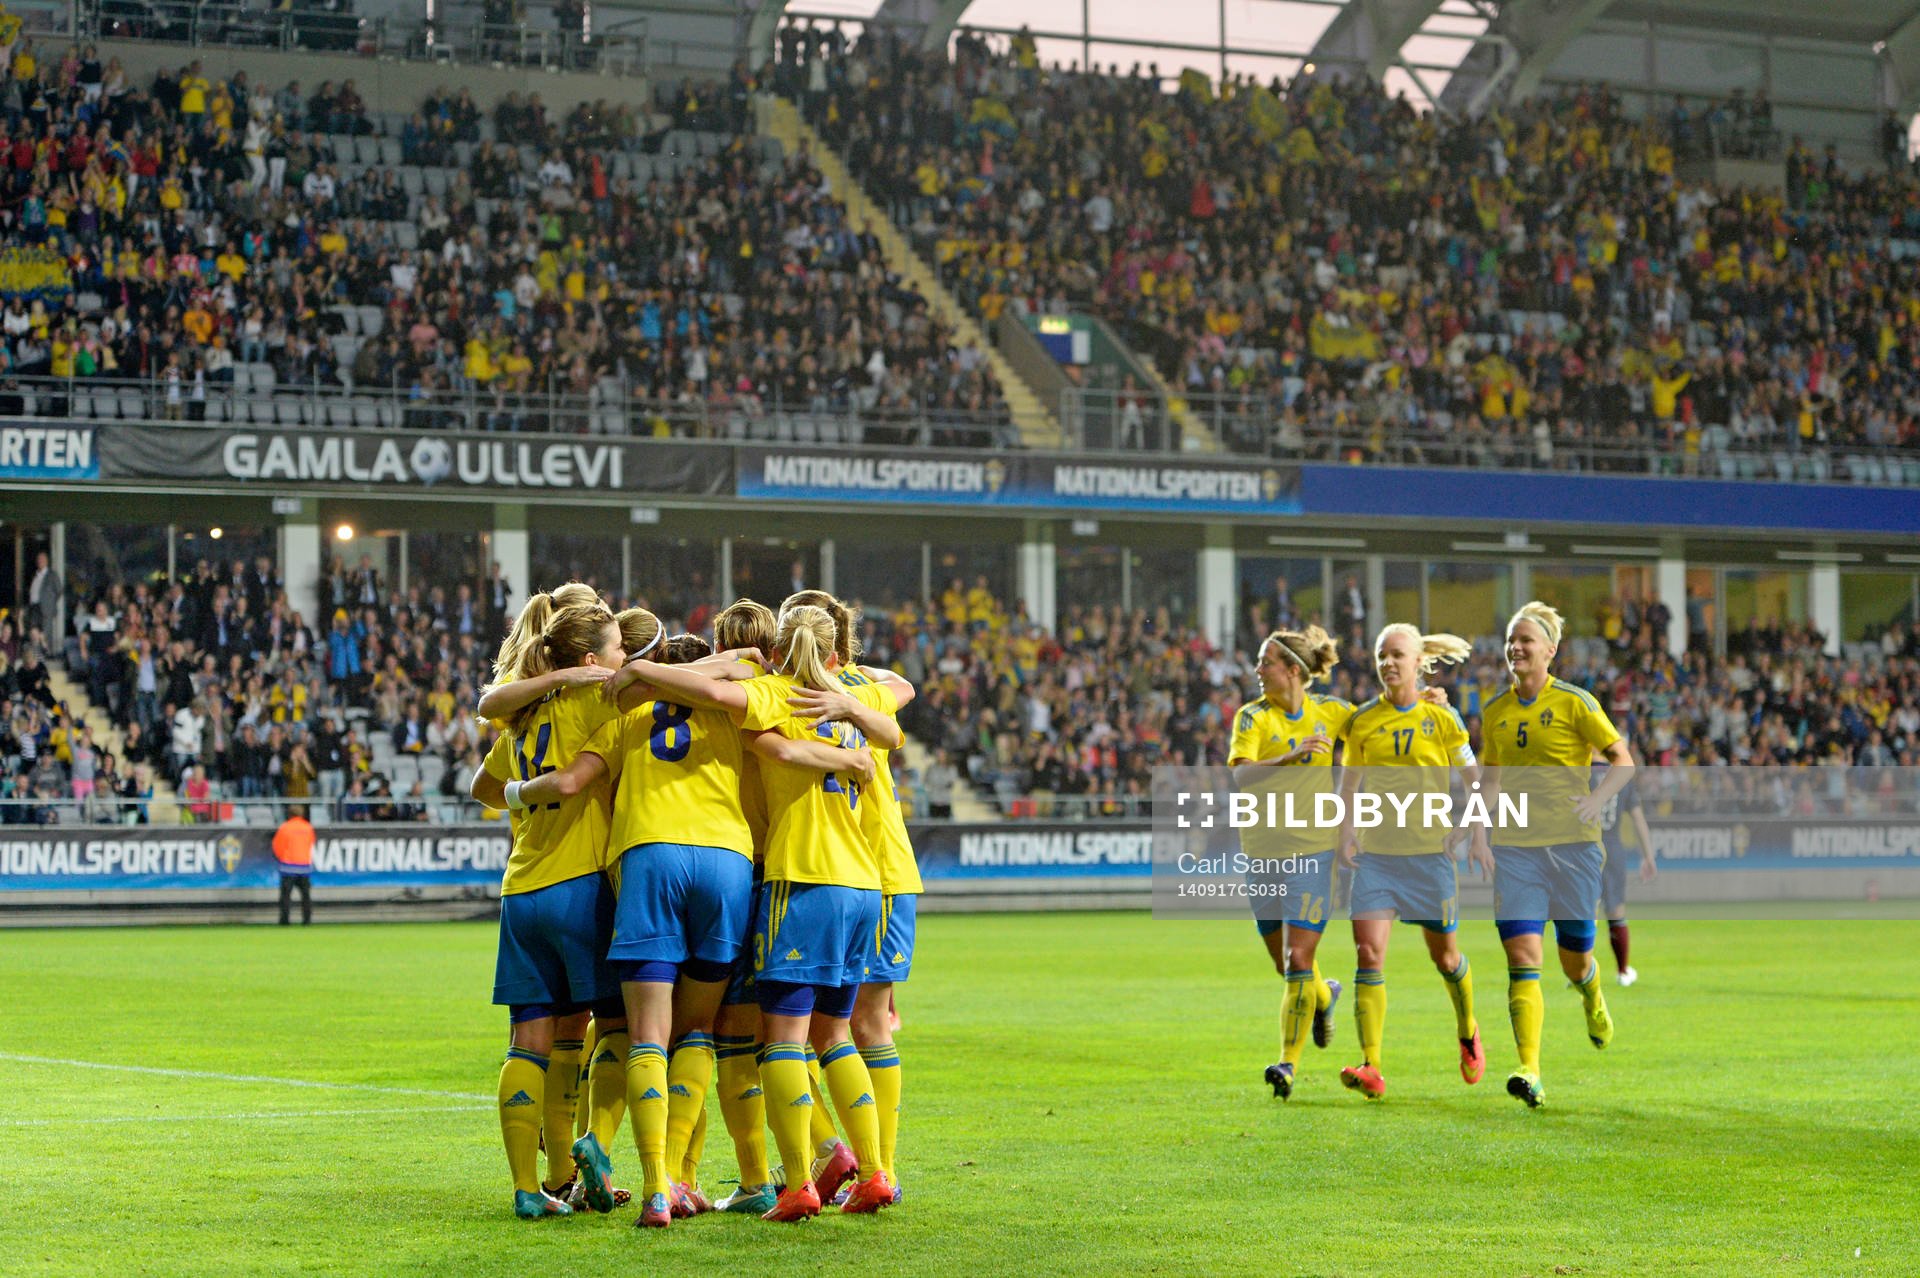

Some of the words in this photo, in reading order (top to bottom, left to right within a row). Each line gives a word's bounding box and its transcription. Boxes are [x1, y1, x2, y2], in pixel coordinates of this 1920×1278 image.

[0, 428, 92, 468] RTEN
[223, 434, 409, 482] GAMLA
[457, 440, 624, 488] ULLEVI
[763, 456, 984, 492] NATIONALSPORTEN
[1053, 466, 1261, 502] NATIONALSPORTEN
[650, 700, 692, 762] 8
[1392, 728, 1415, 756] 17
[1516, 721, 1529, 749] 5
[1299, 893, 1324, 924] 16
